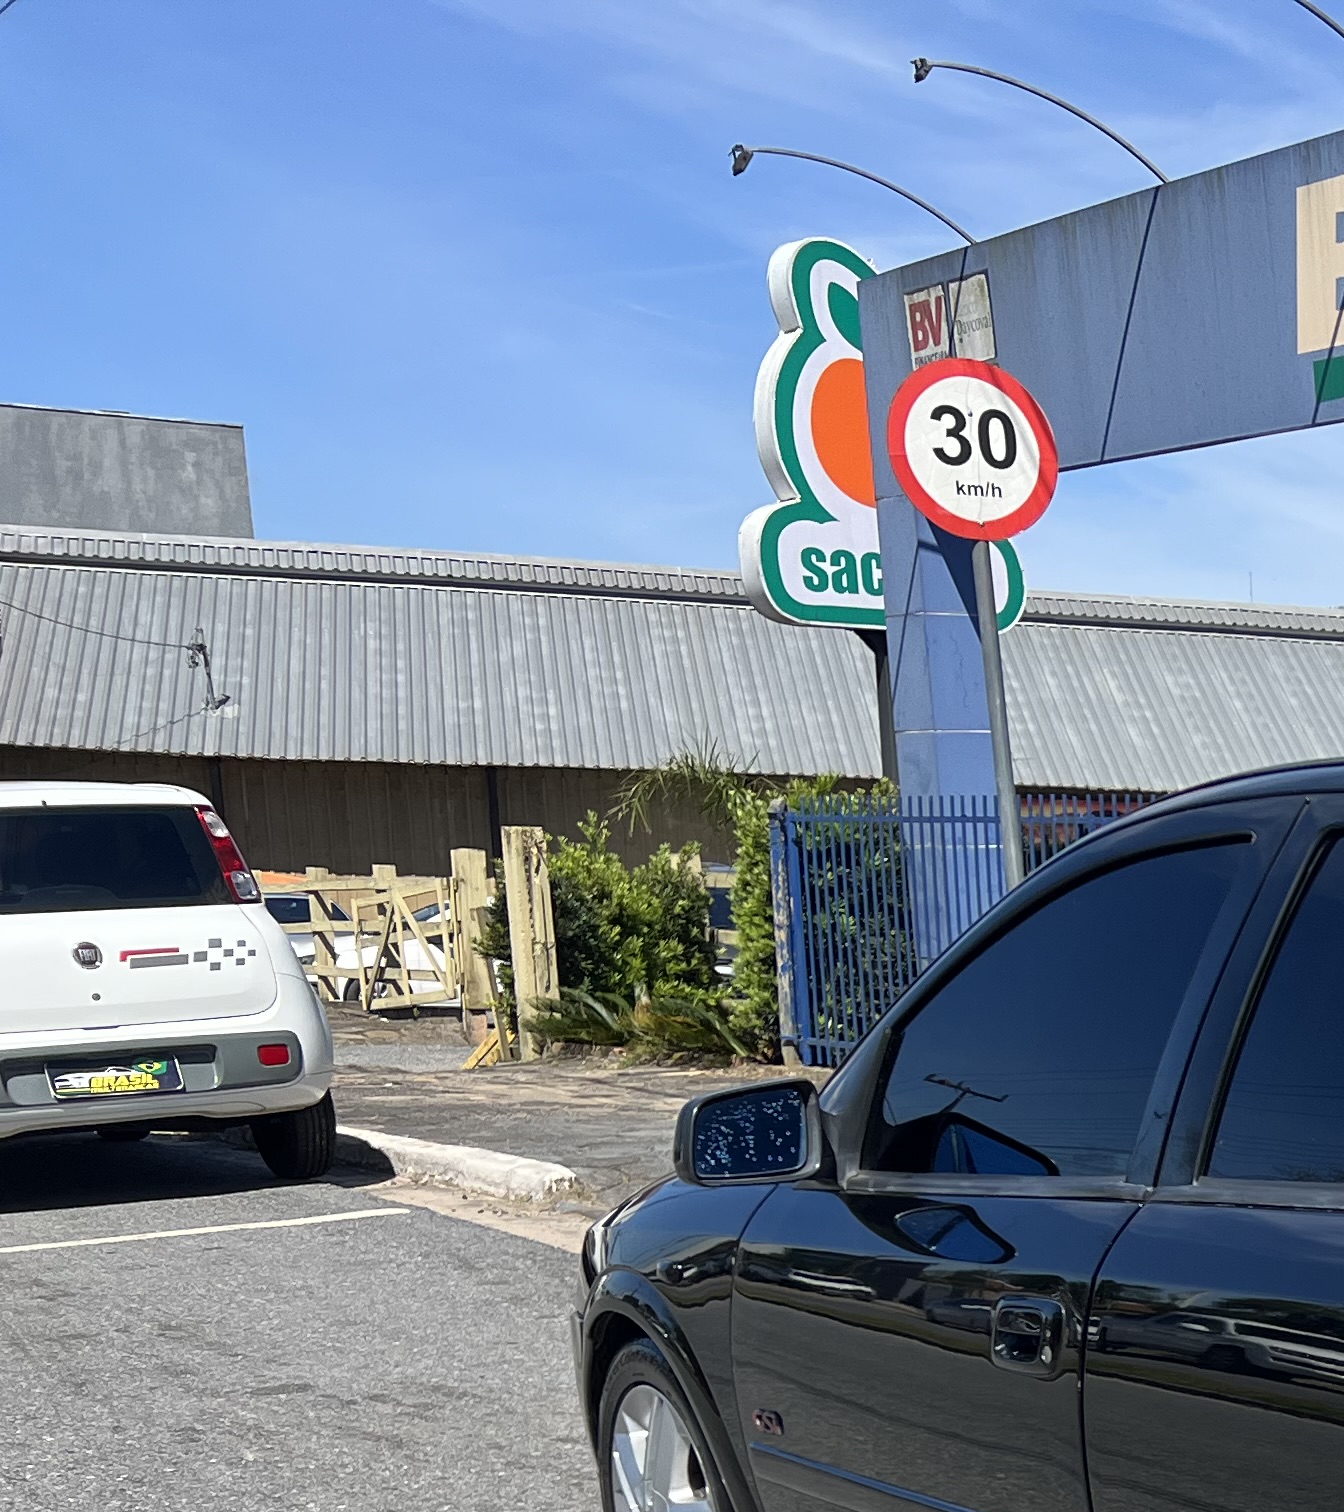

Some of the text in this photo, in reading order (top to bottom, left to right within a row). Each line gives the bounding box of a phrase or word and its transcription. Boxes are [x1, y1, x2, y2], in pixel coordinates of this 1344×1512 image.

[909, 295, 943, 352] BV
[930, 405, 1017, 470] 30
[955, 480, 1003, 498] km/h
[90, 1073, 157, 1088] BRASIL
